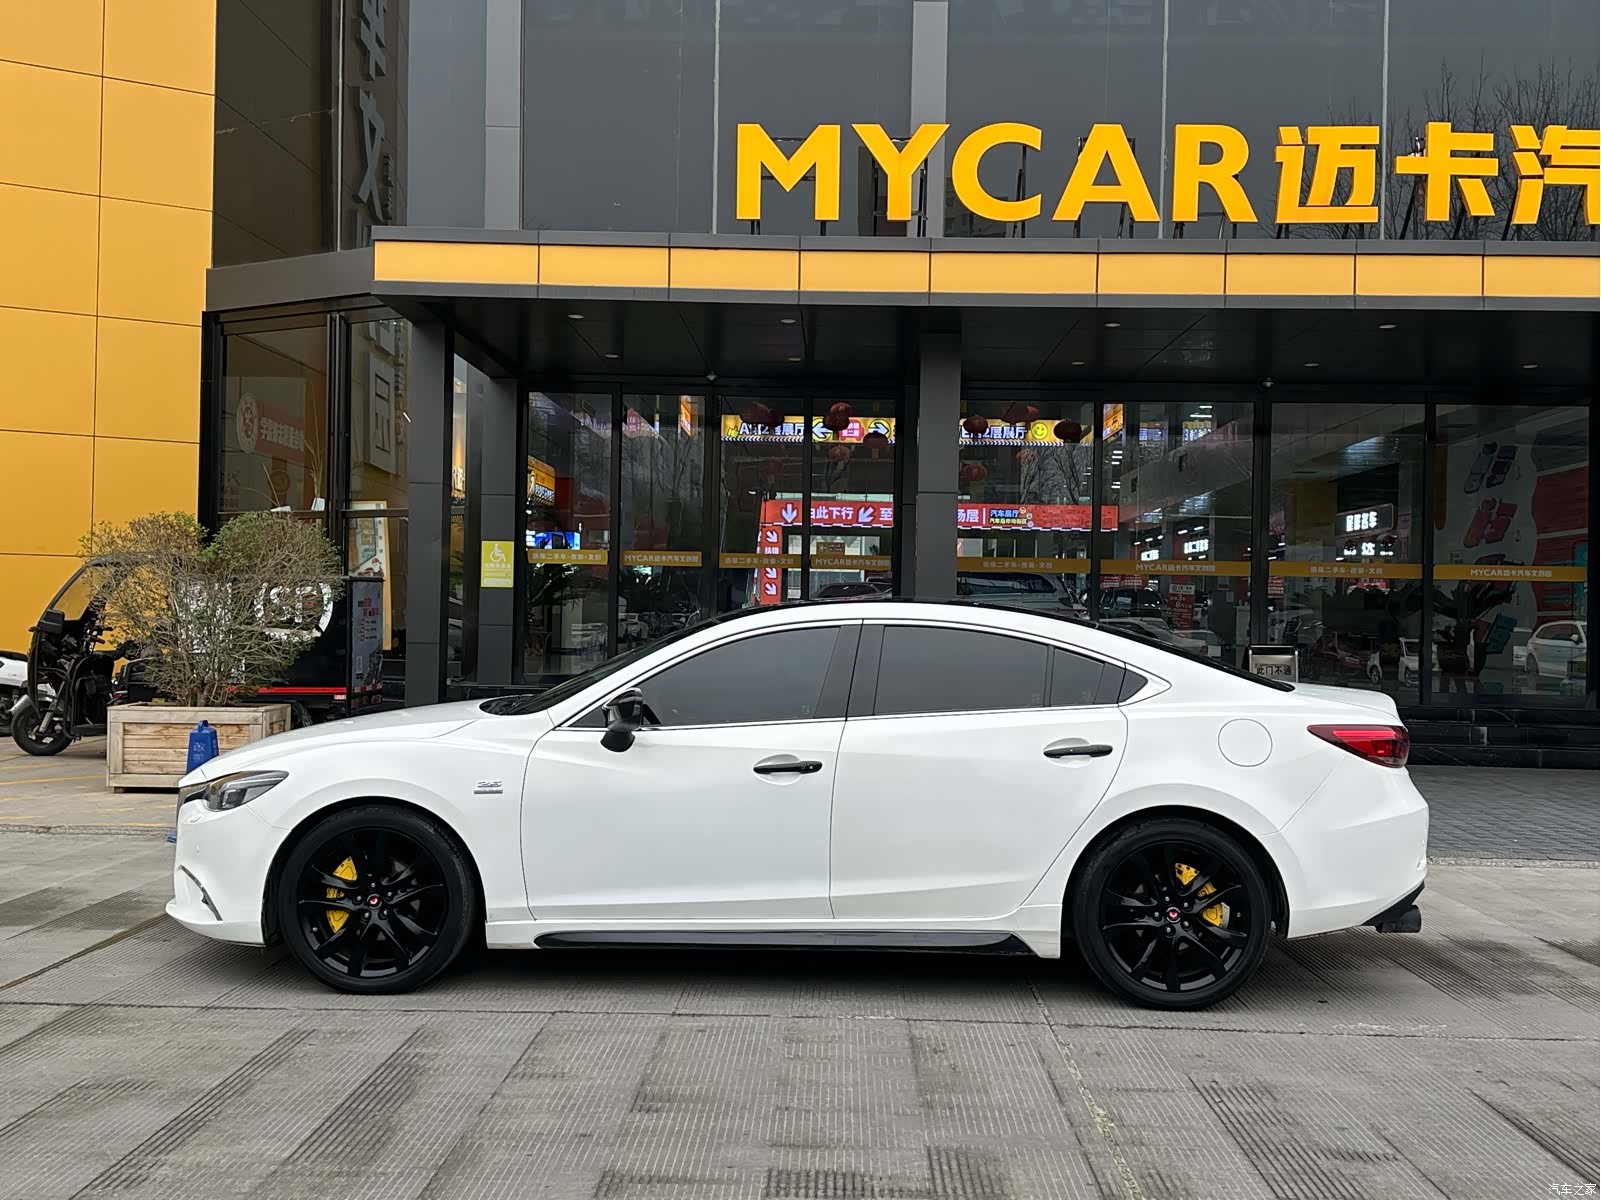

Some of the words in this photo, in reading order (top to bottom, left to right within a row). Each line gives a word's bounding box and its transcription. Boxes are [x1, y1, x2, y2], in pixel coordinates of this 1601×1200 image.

[961, 426, 1027, 439] E2层展厅
[1256, 664, 1291, 676] 此门不通
